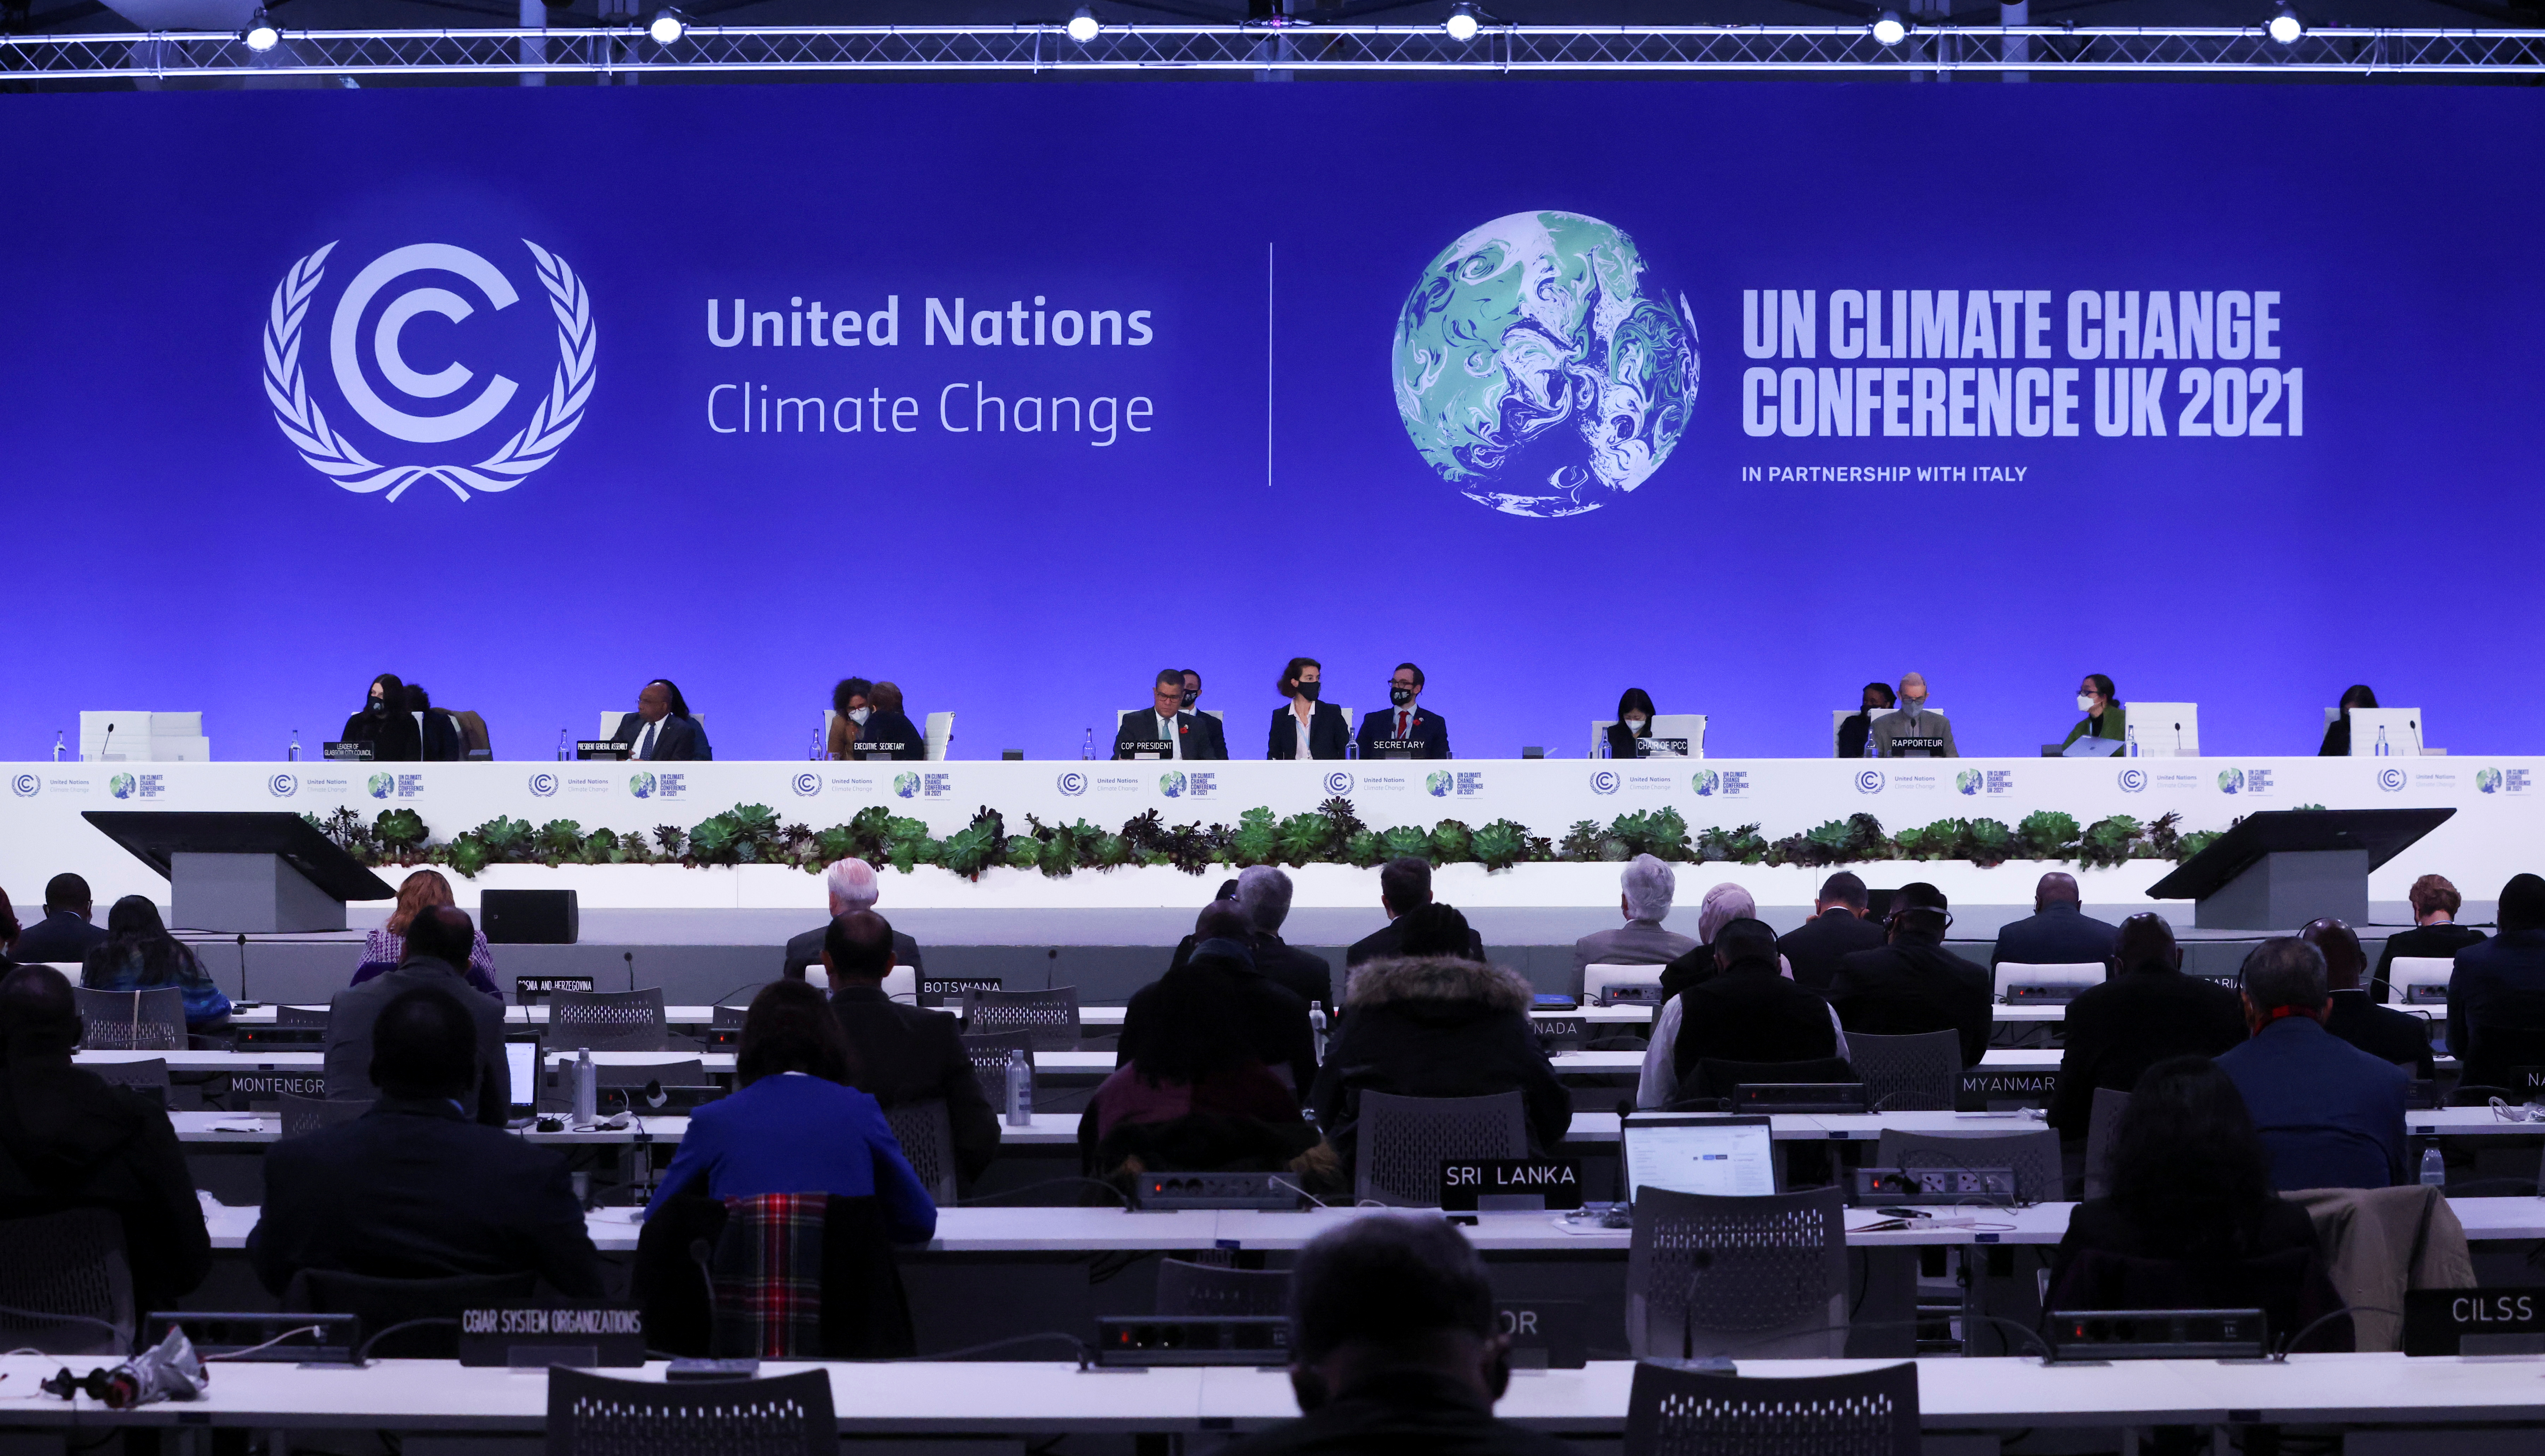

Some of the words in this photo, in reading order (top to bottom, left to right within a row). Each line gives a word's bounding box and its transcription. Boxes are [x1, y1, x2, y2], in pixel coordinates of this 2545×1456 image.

[708, 295, 898, 347] United
[925, 296, 1153, 346] Nations
[1743, 290, 1814, 358] UN
[1829, 290, 2050, 358] CLIMATE
[2068, 291, 2279, 359] CHANGE
[1743, 367, 2078, 436] CONFERENCE
[2095, 368, 2166, 436] UK
[2179, 368, 2302, 436] 2021
[707, 382, 918, 432] Climate
[940, 381, 1153, 446] Change
[1743, 467, 1761, 481] IN
[1769, 467, 1910, 481] PARTNERSHIP
[1918, 467, 1966, 481] WITH
[1973, 467, 2027, 481] ITALY
[1660, 741, 1669, 750] OF
[1671, 741, 1687, 750] IPCC
[541, 981, 552, 990] AND
[554, 981, 592, 991] HERZEGOVINA
[924, 982, 1000, 992] BOTSWANA
[1528, 1023, 1577, 1034] NADA
[1963, 1077, 2055, 1091] MYANMAR
[1447, 1166, 1481, 1186] SRI
[1497, 1166, 1575, 1185] LANKA
[2452, 1296, 2532, 1322] CILSS
[463, 1310, 497, 1333] CGIAR
[501, 1310, 548, 1333] SYSTEM
[552, 1310, 641, 1333] ORGANIZATIONS
